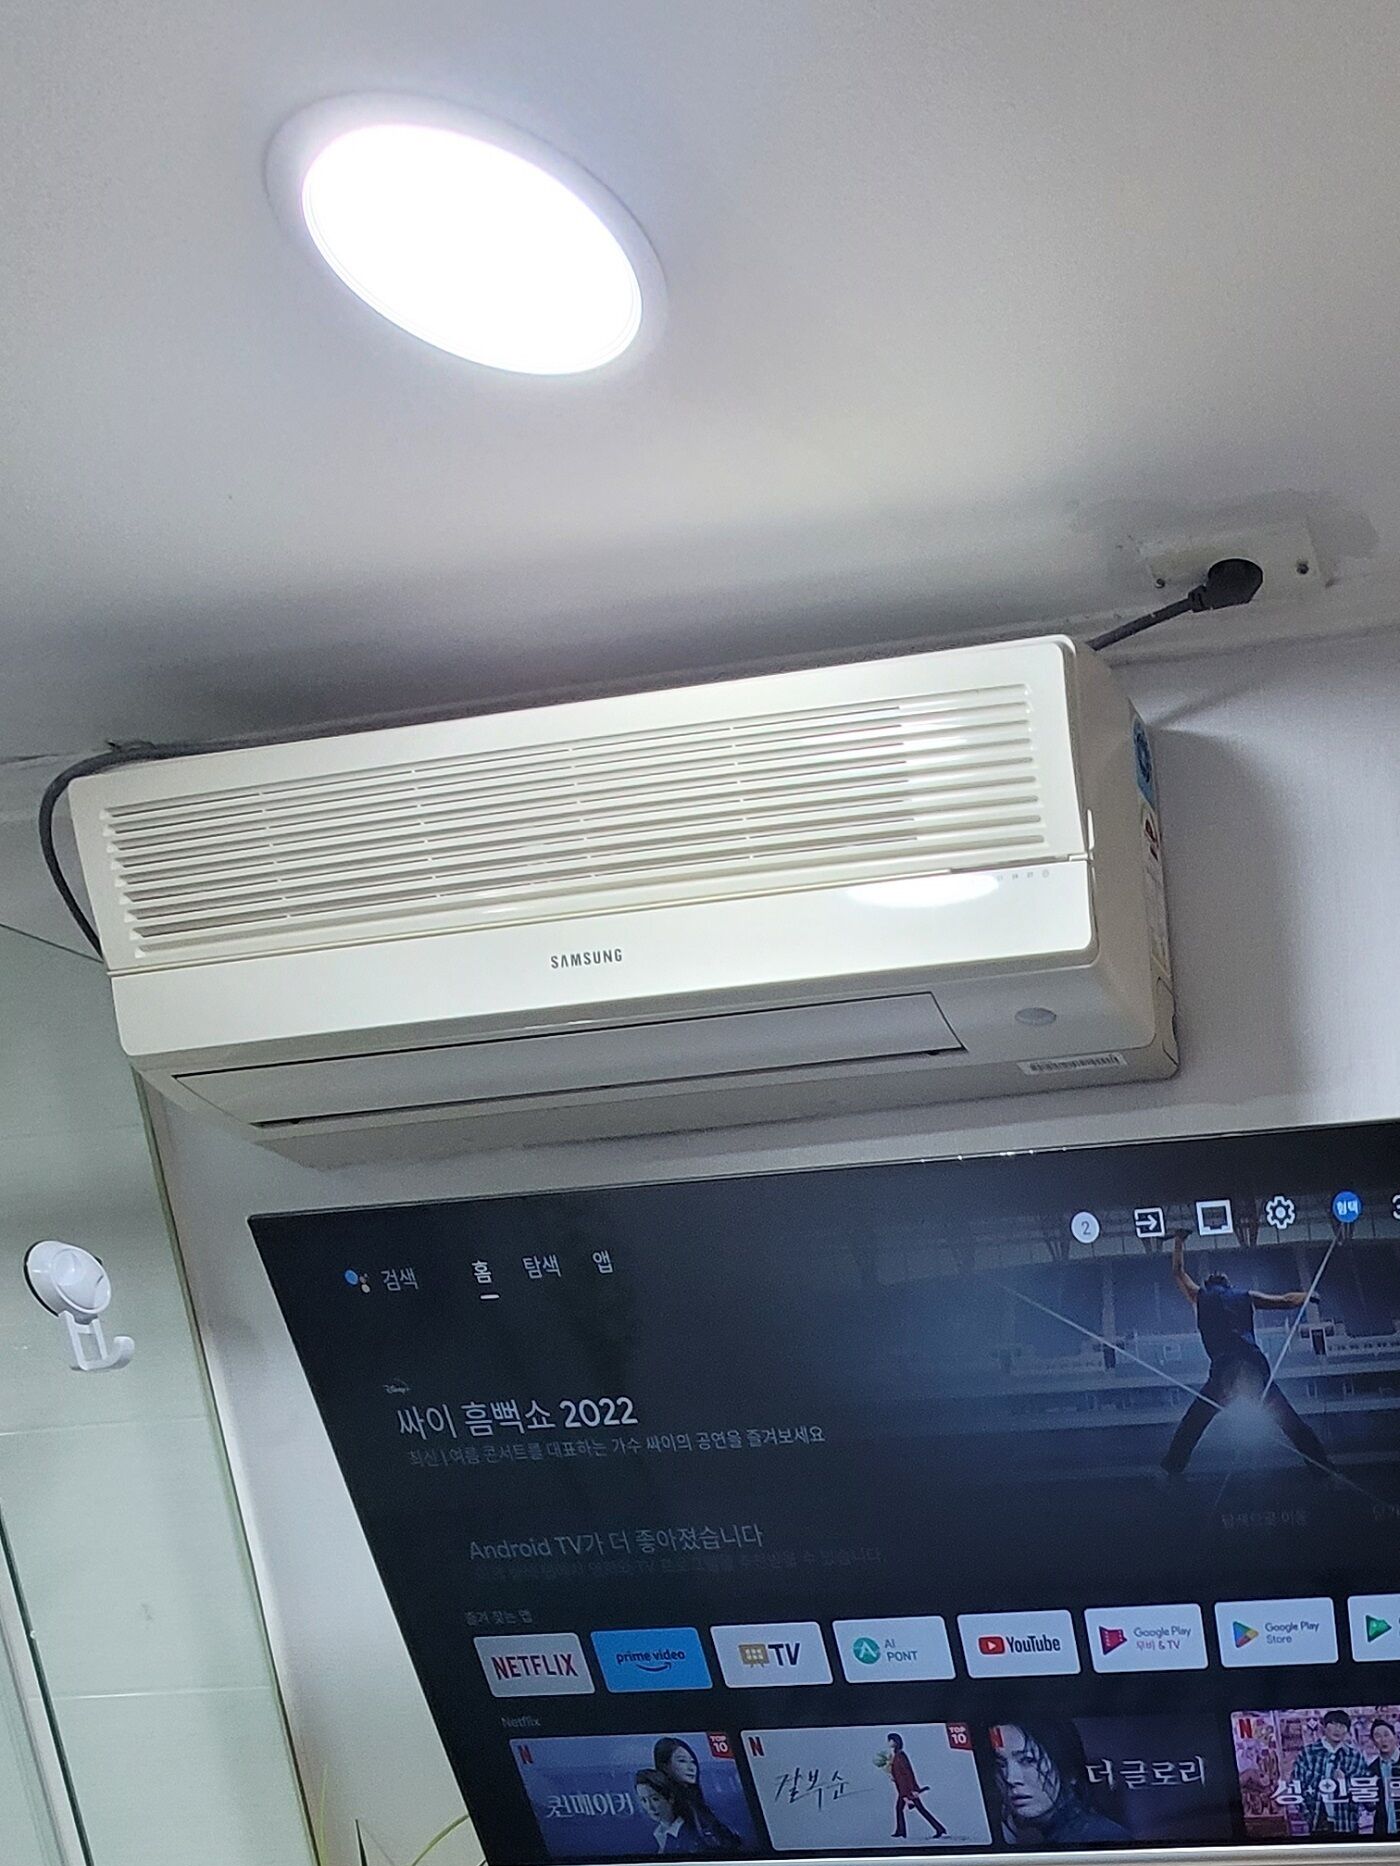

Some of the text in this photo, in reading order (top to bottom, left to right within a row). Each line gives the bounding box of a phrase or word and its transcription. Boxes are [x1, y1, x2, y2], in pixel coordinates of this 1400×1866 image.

[550, 948, 622, 969] SAMSUNG
[472, 1259, 493, 1284] 홈
[522, 1254, 562, 1279] 탐색
[592, 1250, 614, 1274] 앱
[381, 1267, 419, 1291] 검색
[396, 1396, 638, 1440] 싸이 흠뻑쇼 2022
[611, 1436, 642, 1454] 가수
[646, 1433, 693, 1451] 싸이의
[746, 1425, 826, 1446] 즐겨보세요
[469, 1524, 764, 1560] Android TV가 더 좋아졌습니다
[1133, 1625, 1191, 1639] Google Play
[1265, 1620, 1320, 1634] Google Play
[1006, 1634, 1061, 1654] YouTube
[1167, 1639, 1181, 1650] TV
[1266, 1634, 1292, 1644] Store
[616, 1648, 686, 1665] prime video
[767, 1642, 801, 1667] TV
[887, 1650, 918, 1662] PONT
[490, 1653, 579, 1681] NETFLIX
[501, 1716, 541, 1728] Netflix
[949, 1726, 966, 1734] TOP
[709, 1734, 727, 1743] TOP
[712, 1741, 728, 1753] 10
[951, 1733, 967, 1744] 10
[1085, 1755, 1207, 1790] 더 글로리
